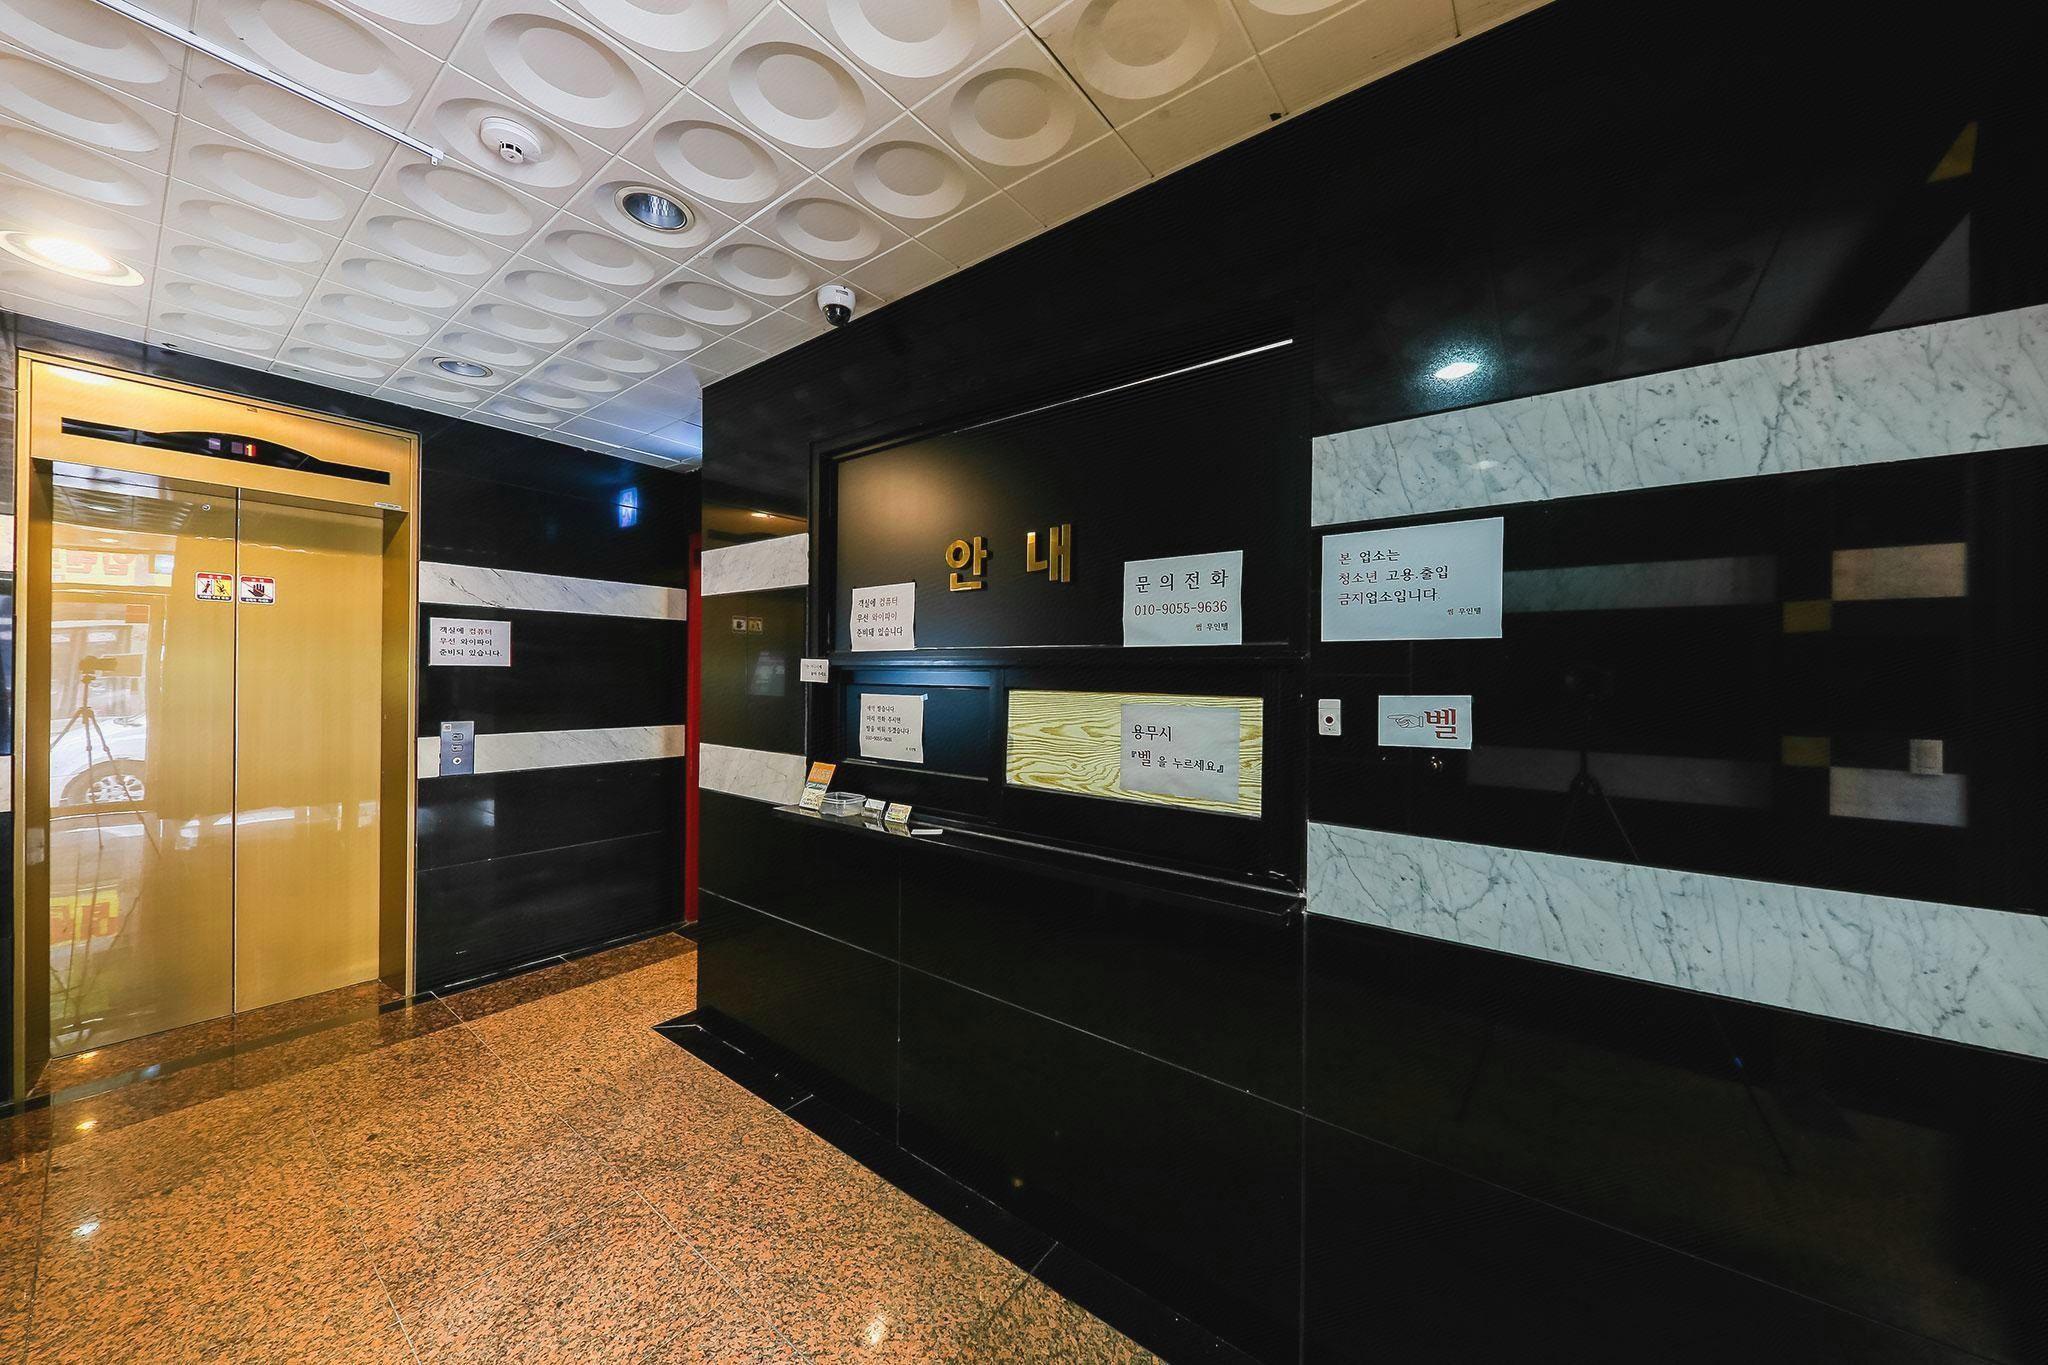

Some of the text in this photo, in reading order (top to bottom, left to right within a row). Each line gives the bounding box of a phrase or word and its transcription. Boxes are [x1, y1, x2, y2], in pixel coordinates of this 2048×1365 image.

[1339, 549, 1400, 565] 본 업소는
[1338, 570, 1378, 585] 청소년
[1134, 600, 1228, 616] 010-9055-9636
[460, 638, 492, 646] 와이파이
[1424, 708, 1458, 740] 벨
[1131, 724, 1171, 742] 용무시
[1157, 755, 1168, 768] 을
